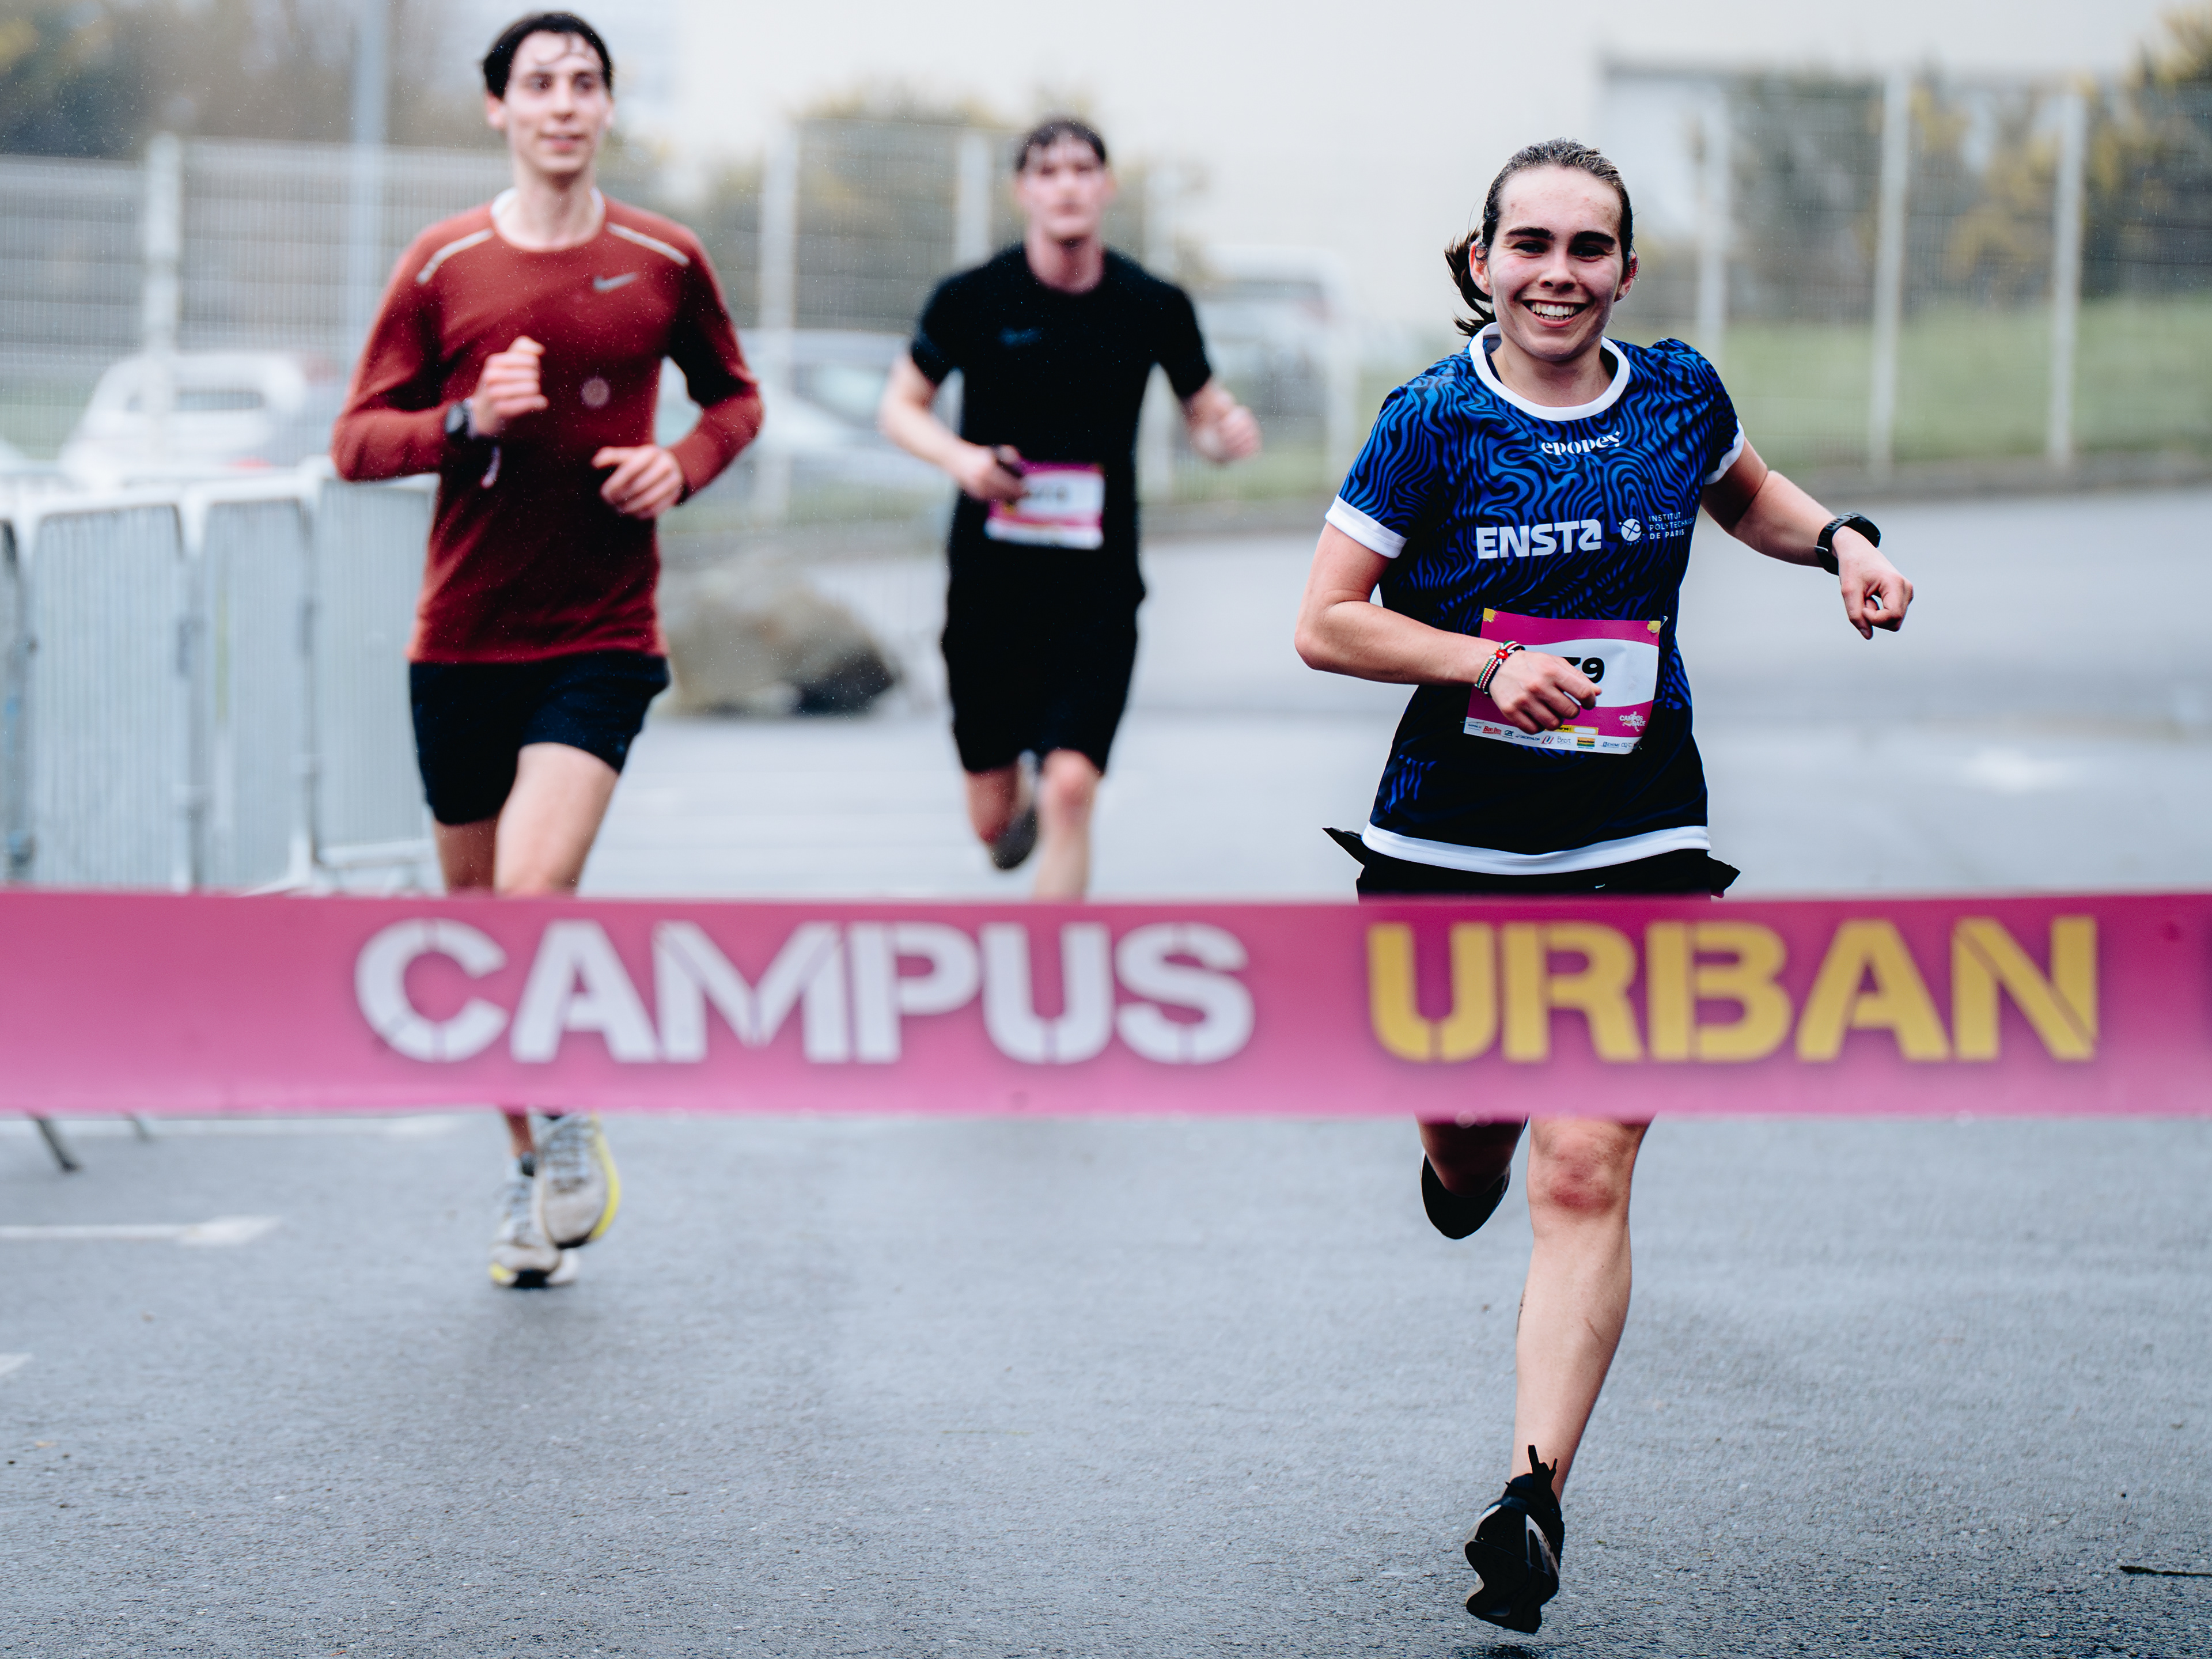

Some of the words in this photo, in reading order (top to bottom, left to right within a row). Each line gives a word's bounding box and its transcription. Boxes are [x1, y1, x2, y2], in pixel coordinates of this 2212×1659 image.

[1649, 512, 1681, 522] INSTITUT
[1665, 529, 1684, 538] PARIS
[355, 917, 1255, 1066] CAMPUS
[1366, 915, 2098, 1063] URBAN
